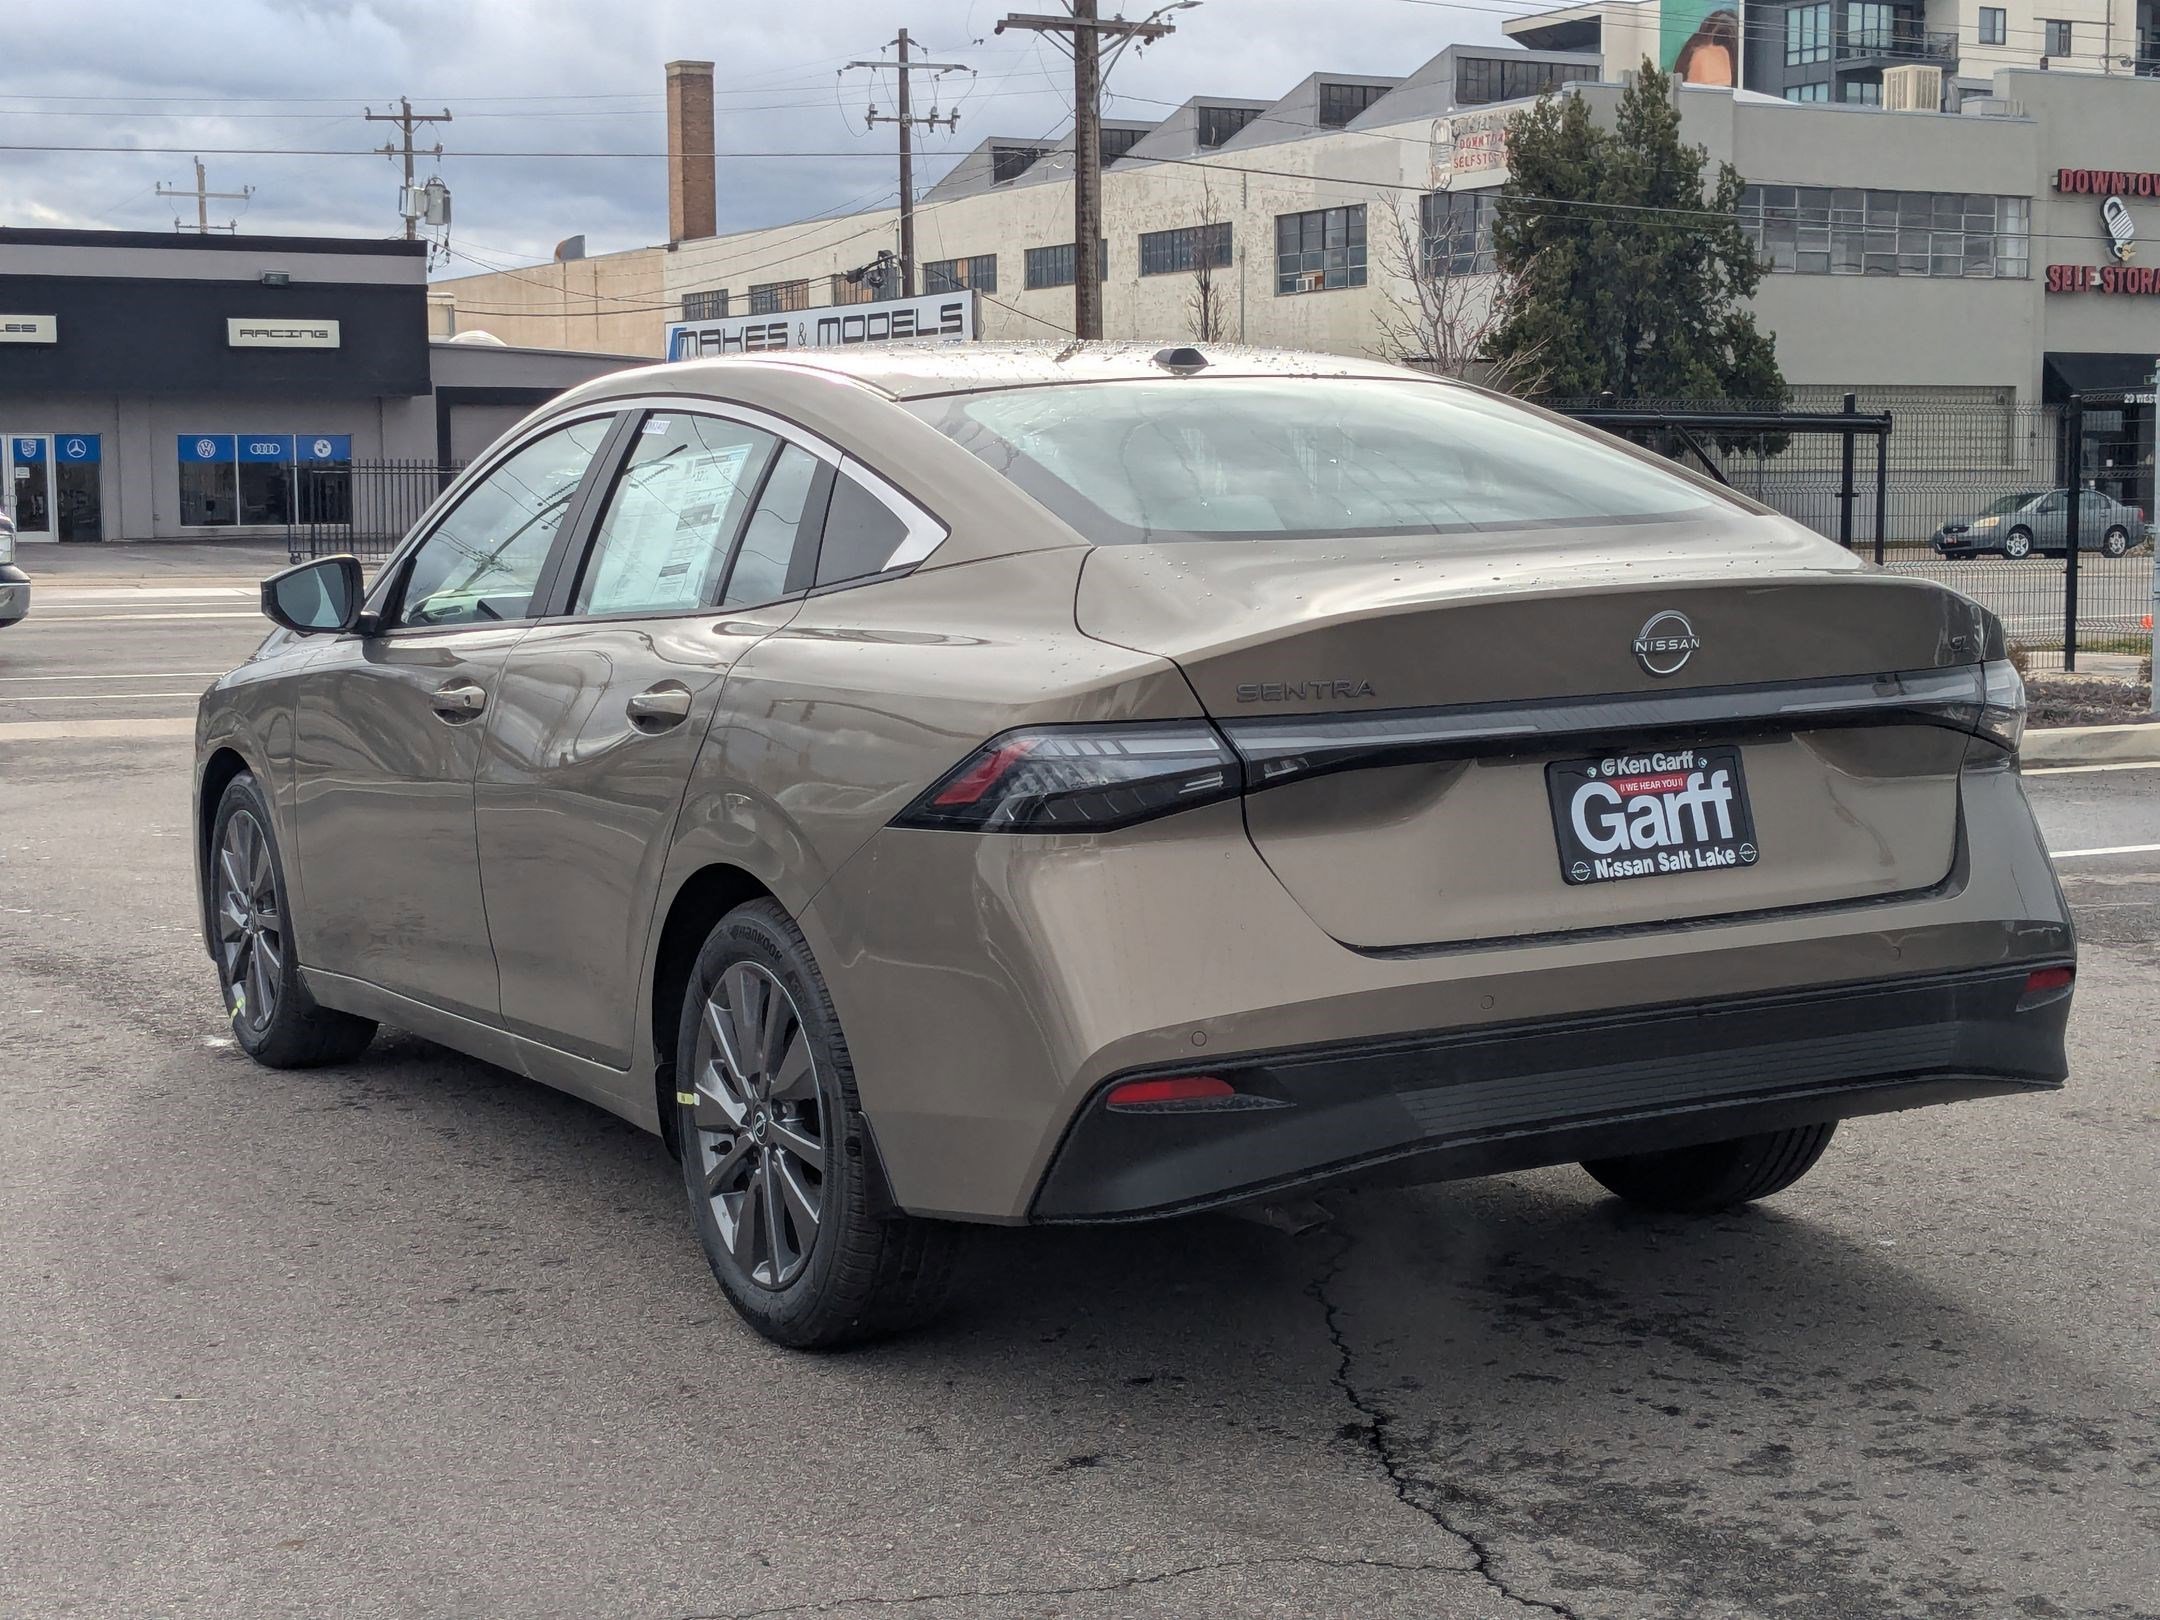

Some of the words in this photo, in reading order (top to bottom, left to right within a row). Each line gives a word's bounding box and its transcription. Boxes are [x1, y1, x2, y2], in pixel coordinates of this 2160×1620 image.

[2047, 265, 2097, 292] SELF
[239, 329, 329, 339] RACING
[678, 322, 788, 357] MAKES
[797, 322, 808, 346] &
[817, 302, 963, 346] MODELS
[1635, 638, 1700, 652] NISSAN
[1237, 679, 1376, 702] SENTRA
[1617, 755, 1651, 775] Ken
[1653, 750, 1694, 772] Garff
[1626, 782, 1640, 792] WE
[1640, 779, 1661, 790] HEAR
[1662, 778, 1678, 788] YOU
[1571, 769, 1734, 855] Garff
[1594, 858, 1655, 879] Nissan
[1658, 849, 1692, 872] Salt
[1697, 846, 1736, 868] Lake
